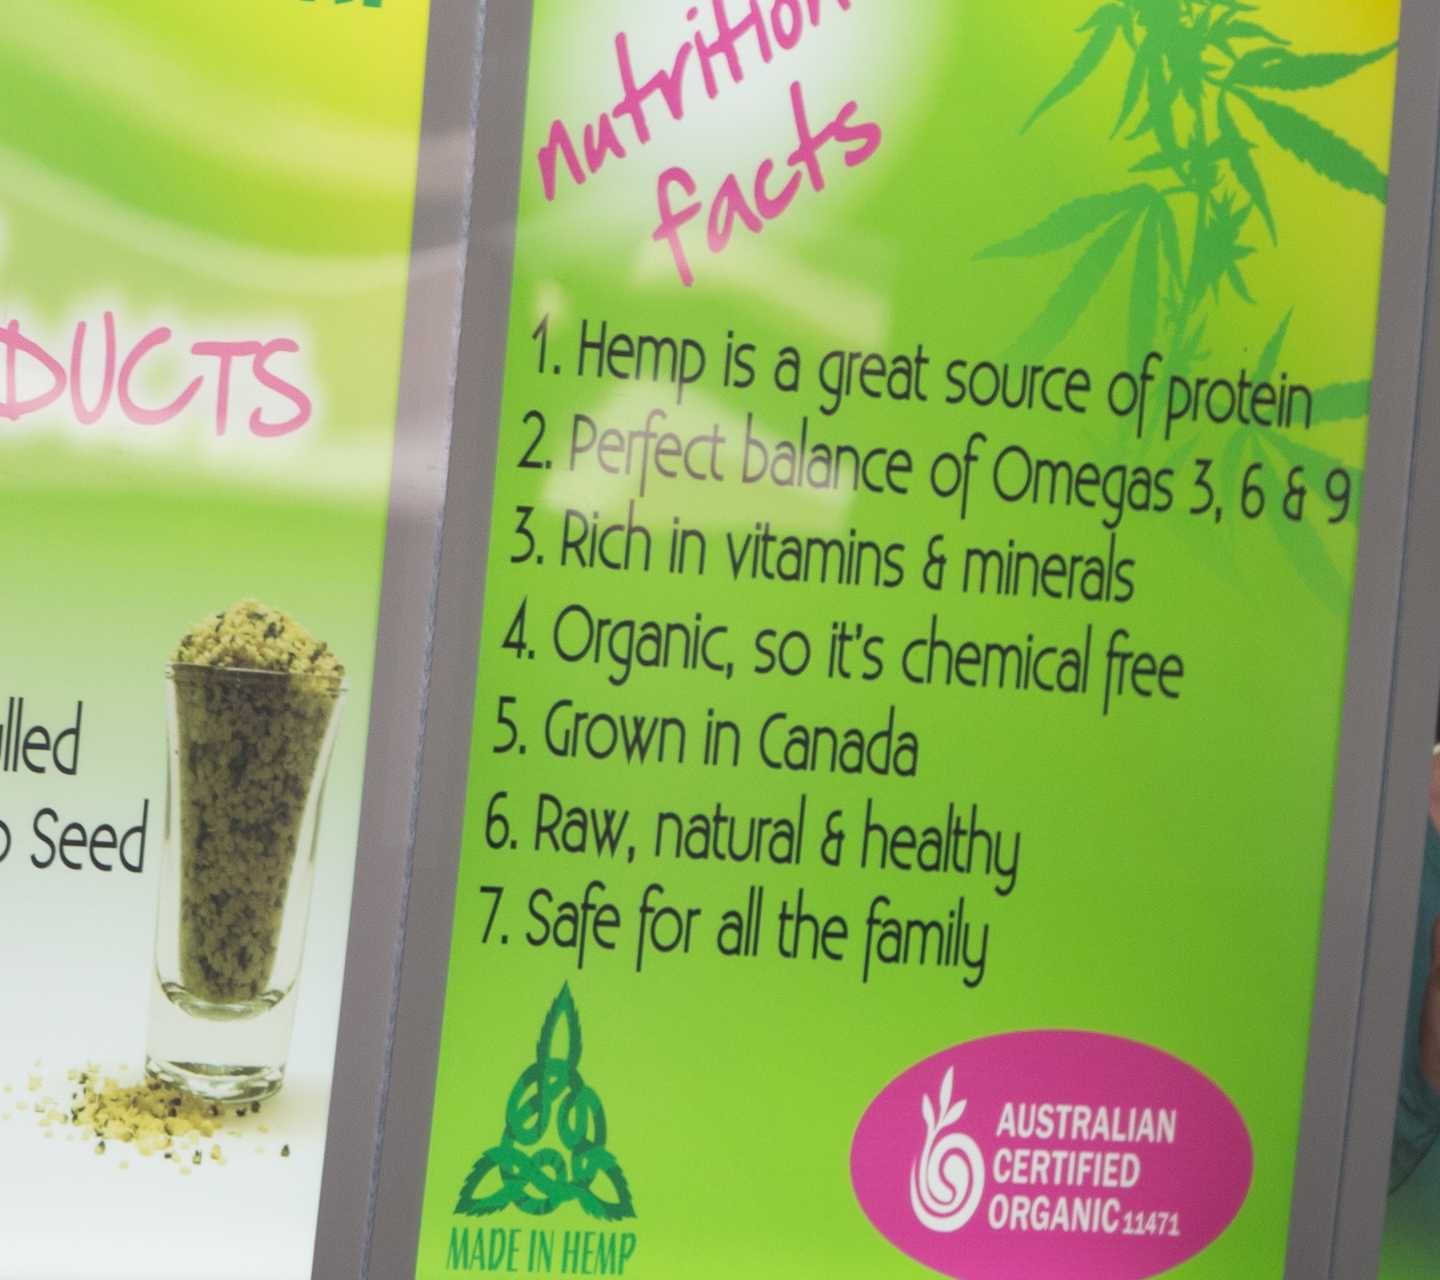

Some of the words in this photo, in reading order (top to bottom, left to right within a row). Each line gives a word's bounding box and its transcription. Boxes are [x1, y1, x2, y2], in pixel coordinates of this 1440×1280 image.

[651, 81, 883, 288] facts
[531, 313, 561, 375] 1.
[578, 319, 706, 405] Hemp
[724, 330, 756, 388] is
[774, 346, 801, 392] a
[819, 344, 929, 416] great
[945, 359, 1091, 414] source
[1107, 351, 1162, 439] of
[1165, 369, 1313, 440] protein
[517, 410, 552, 470] 2.
[569, 408, 726, 498] Perfect
[742, 412, 913, 494] balance
[930, 432, 987, 520] of
[993, 445, 1174, 529] Omegas
[1189, 459, 1221, 524] 3,
[1241, 462, 1265, 519] 6
[1282, 465, 1307, 521] &
[1325, 467, 1351, 524] 9
[510, 505, 544, 564] 3.
[561, 499, 651, 571] Rich
[669, 516, 706, 575] in
[726, 522, 905, 588] vitamins
[922, 534, 947, 590] &
[962, 532, 1135, 603] minerals
[502, 595, 535, 660] 4.
[553, 603, 734, 687] Organic,
[754, 628, 811, 676] so
[828, 621, 884, 681] it's
[902, 614, 1092, 694] chemical
[1104, 628, 1184, 714] free
[492, 696, 526, 755] 5.
[545, 699, 686, 765] Grown
[703, 708, 740, 766] in
[759, 705, 919, 777] Canada
[30, 799, 149, 874] Seed
[484, 791, 518, 850] 6.
[534, 793, 636, 864] Raw,
[654, 793, 807, 864] natural
[820, 809, 845, 866] &
[860, 797, 1020, 896] healthy
[478, 886, 509, 945] 7.
[525, 880, 621, 970] Safe
[635, 883, 702, 973] for
[716, 885, 764, 957] all
[777, 888, 849, 961] the
[862, 895, 989, 988] family
[992, 1148, 1141, 1188] CERTIFIED
[995, 1102, 1177, 1144] AUSTRALIAN
[446, 1226, 521, 1273] MADE
[527, 1228, 554, 1273] IN
[561, 1231, 637, 1276] HEMP
[987, 1195, 1121, 1235] ORGANIC
[1121, 1211, 1181, 1238] 11471
